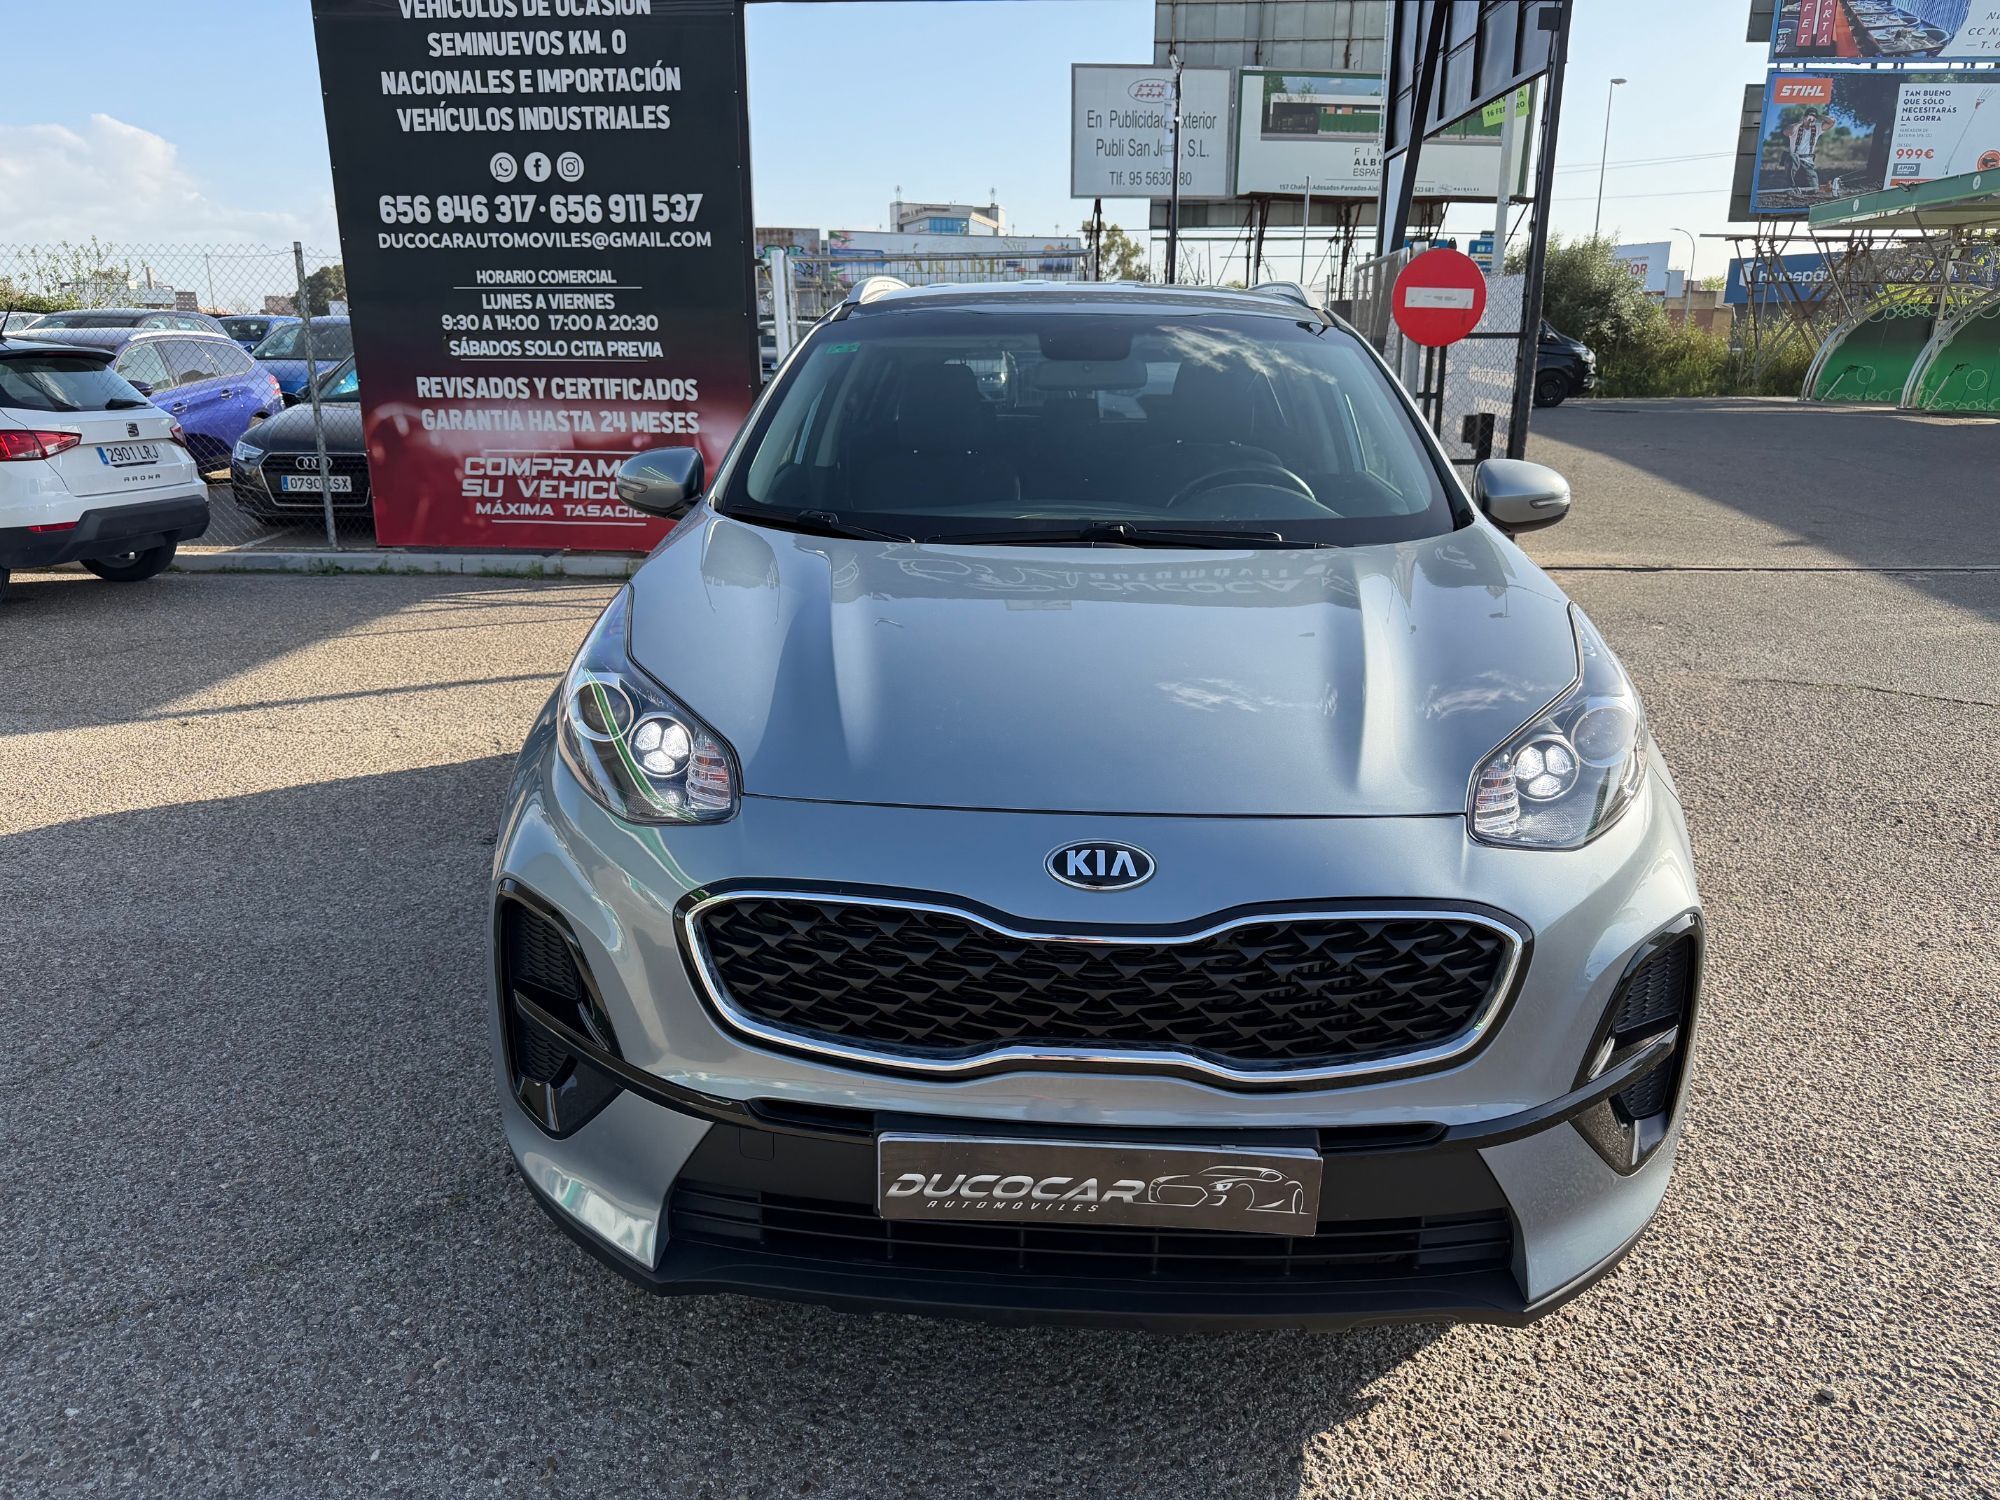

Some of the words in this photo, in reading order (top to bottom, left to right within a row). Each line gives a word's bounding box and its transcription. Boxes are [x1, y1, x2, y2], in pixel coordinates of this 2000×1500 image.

[523, 0, 551, 17] DE
[1968, 27, 1985, 36] CC
[427, 31, 564, 57] SEMINUEVOS
[568, 30, 608, 55] KM.
[381, 69, 515, 95] NACIONALES
[520, 70, 533, 94] E
[537, 60, 681, 93] IMPORTACIÓN
[1780, 85, 1825, 97] STIHL
[1902, 105, 1957, 114] NECESITARÁS
[1922, 97, 1944, 105] SÓLO
[397, 101, 514, 132] VEHÍCULOS
[518, 105, 671, 131] INDUSTRIALES
[1087, 110, 1103, 128] En
[1180, 111, 1217, 129] xterior
[1096, 138, 1124, 157] Publi
[1128, 138, 1150, 157] San
[1188, 139, 1210, 158] S.L.
[1896, 148, 1934, 159] 999€
[1109, 171, 1126, 186] Tlf.
[1129, 171, 1142, 186] 95
[1145, 171, 1192, 186] 563080
[379, 195, 432, 224] 656
[437, 195, 489, 224] 846
[609, 194, 647, 223] 911
[653, 193, 703, 223] 537
[378, 231, 712, 250] DUCOCARAUTOMOVILES@GMAIL.COM
[476, 270, 536, 284] HORARIO
[538, 270, 617, 284] COMERCIAL
[482, 293, 533, 310] LUNES
[535, 294, 547, 310] A
[549, 293, 615, 310] VIERNES
[442, 314, 479, 331] 9:30
[482, 315, 494, 331] A
[495, 314, 540, 331] 14:00
[548, 314, 593, 331] 17:00
[596, 315, 607, 331] A
[609, 314, 659, 331] 20:30
[450, 337, 522, 356] SÁBADOS
[524, 340, 568, 356] SOLO
[570, 341, 605, 357] CITA
[607, 341, 664, 358] PREVIA
[416, 376, 530, 400] REVISADOS
[533, 377, 547, 399] Y
[550, 377, 699, 402] CERTIFICADOS
[421, 408, 525, 432] GARANTIA
[528, 410, 596, 433] HASTA
[599, 410, 628, 433] 24
[630, 411, 700, 434] MESES
[106, 446, 137, 463] 2901
[137, 444, 159, 460] LRJ
[464, 456, 626, 478] COMPRAM
[124, 473, 161, 482] ARONA
[290, 477, 321, 490] 0790
[461, 479, 504, 498] SU
[518, 480, 620, 500] VEHIC
[475, 499, 554, 517] MÁXIMA
[563, 504, 650, 519] TASACI
[1065, 851, 1137, 877] KIA
[886, 1173, 1147, 1203] DUCOCAR
